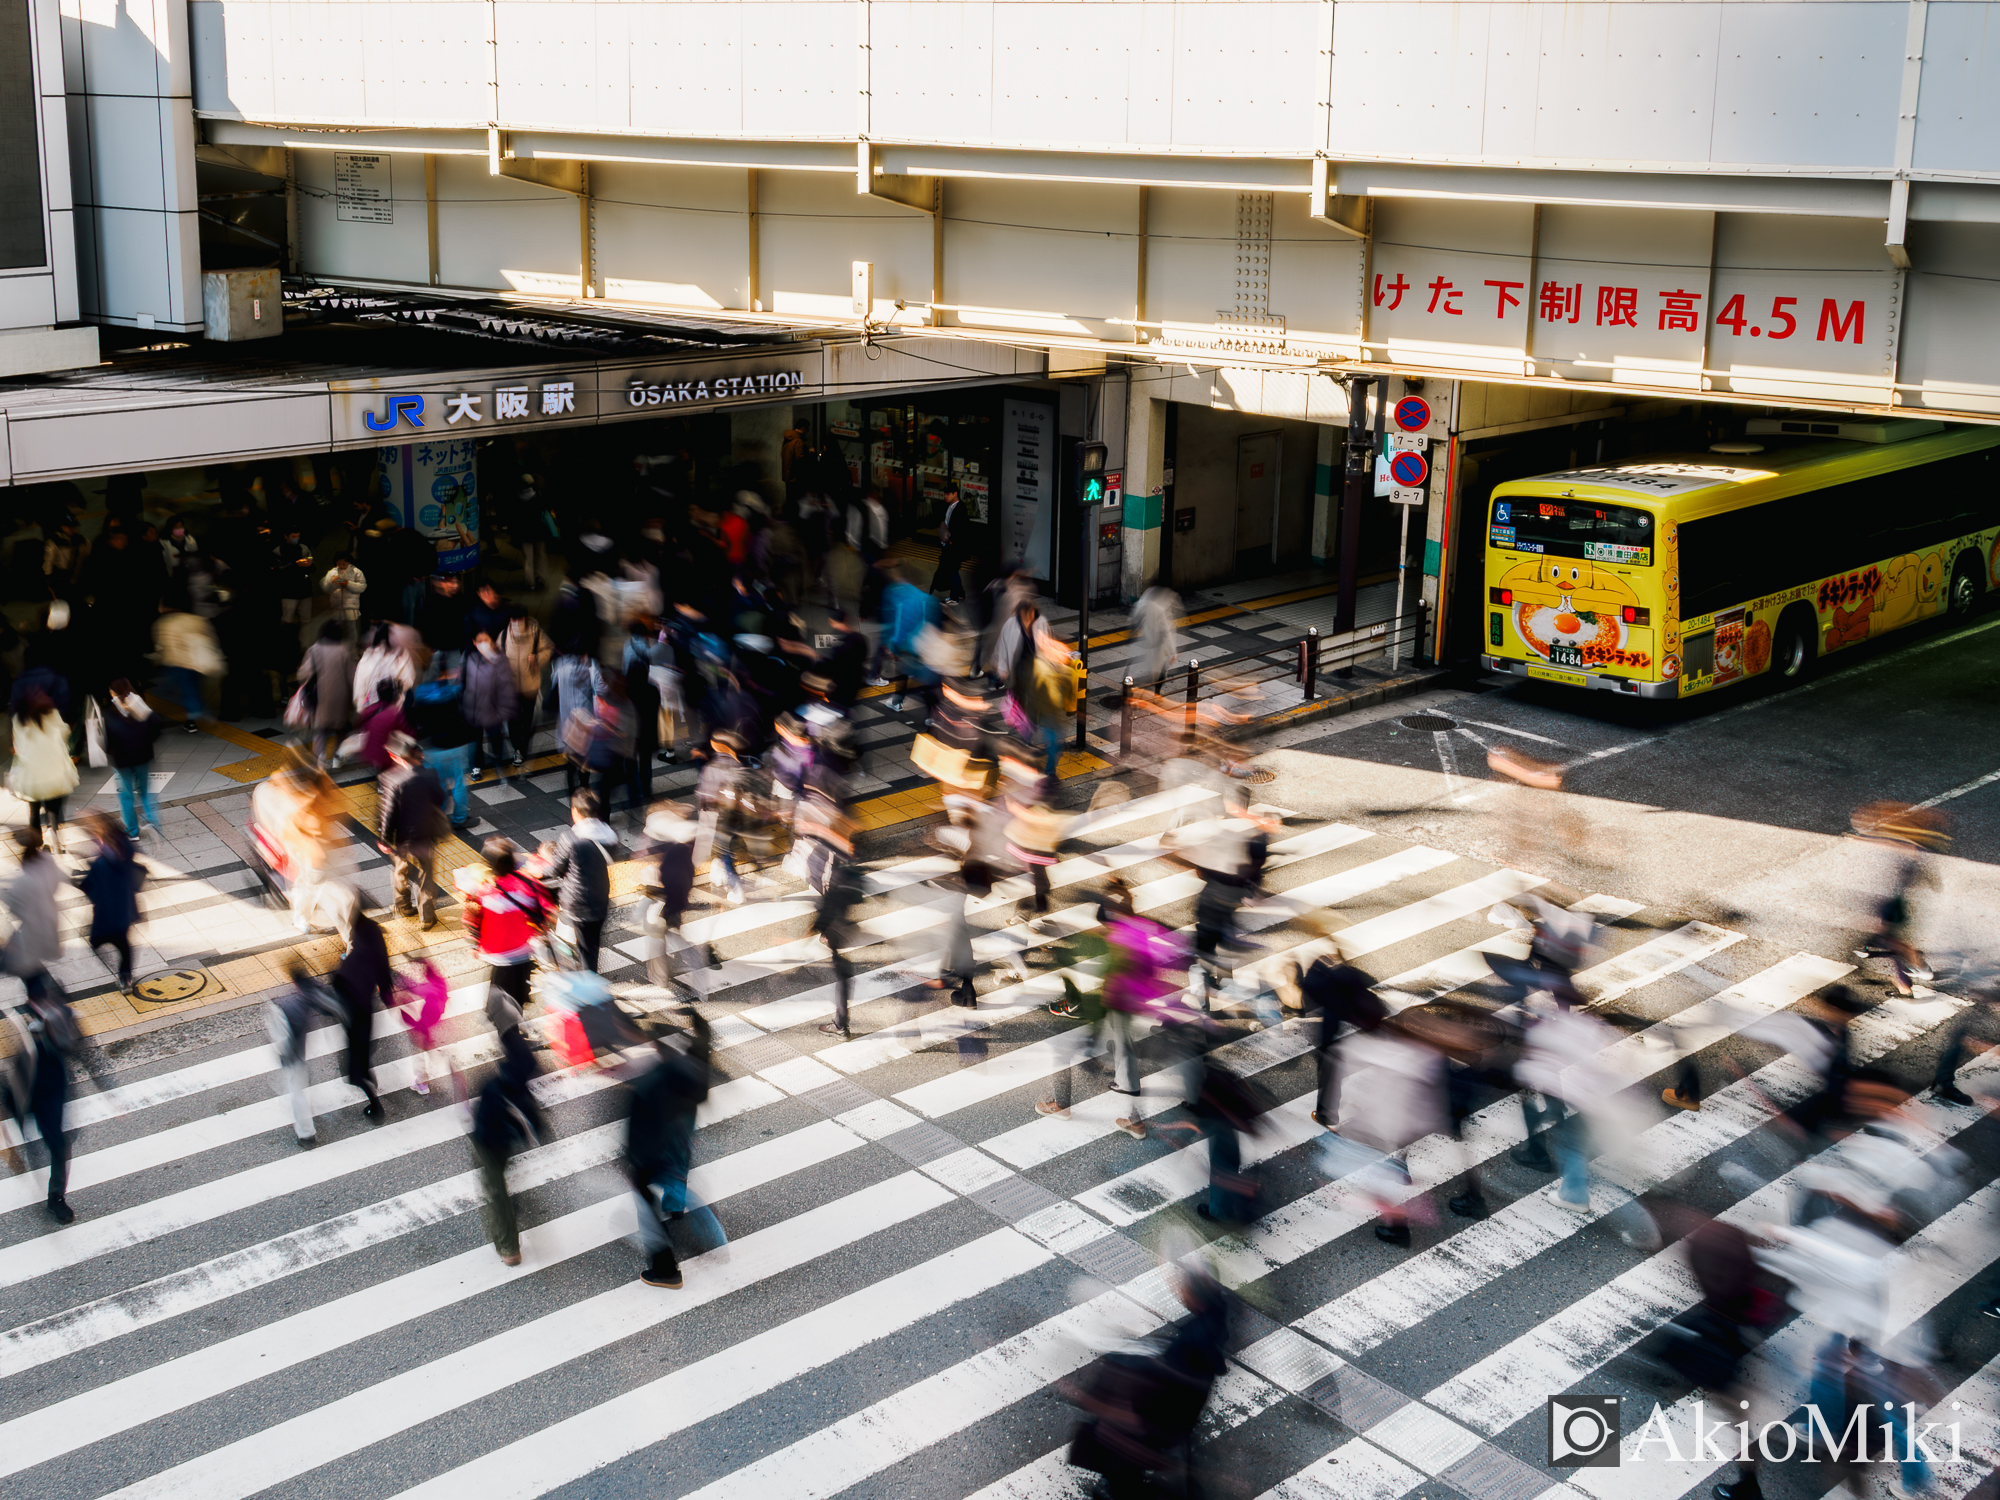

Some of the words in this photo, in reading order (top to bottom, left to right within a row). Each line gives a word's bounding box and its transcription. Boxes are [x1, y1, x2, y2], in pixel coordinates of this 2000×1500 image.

[1373, 273, 1702, 332] けた下制限高
[447, 381, 575, 425] 大阪駅
[714, 371, 805, 399] STATION
[366, 394, 427, 432] JR
[1818, 565, 1882, 614] チキンラーメン
[1687, 614, 1711, 630] 20-1484
[1584, 645, 1652, 669] チキンラーメン
